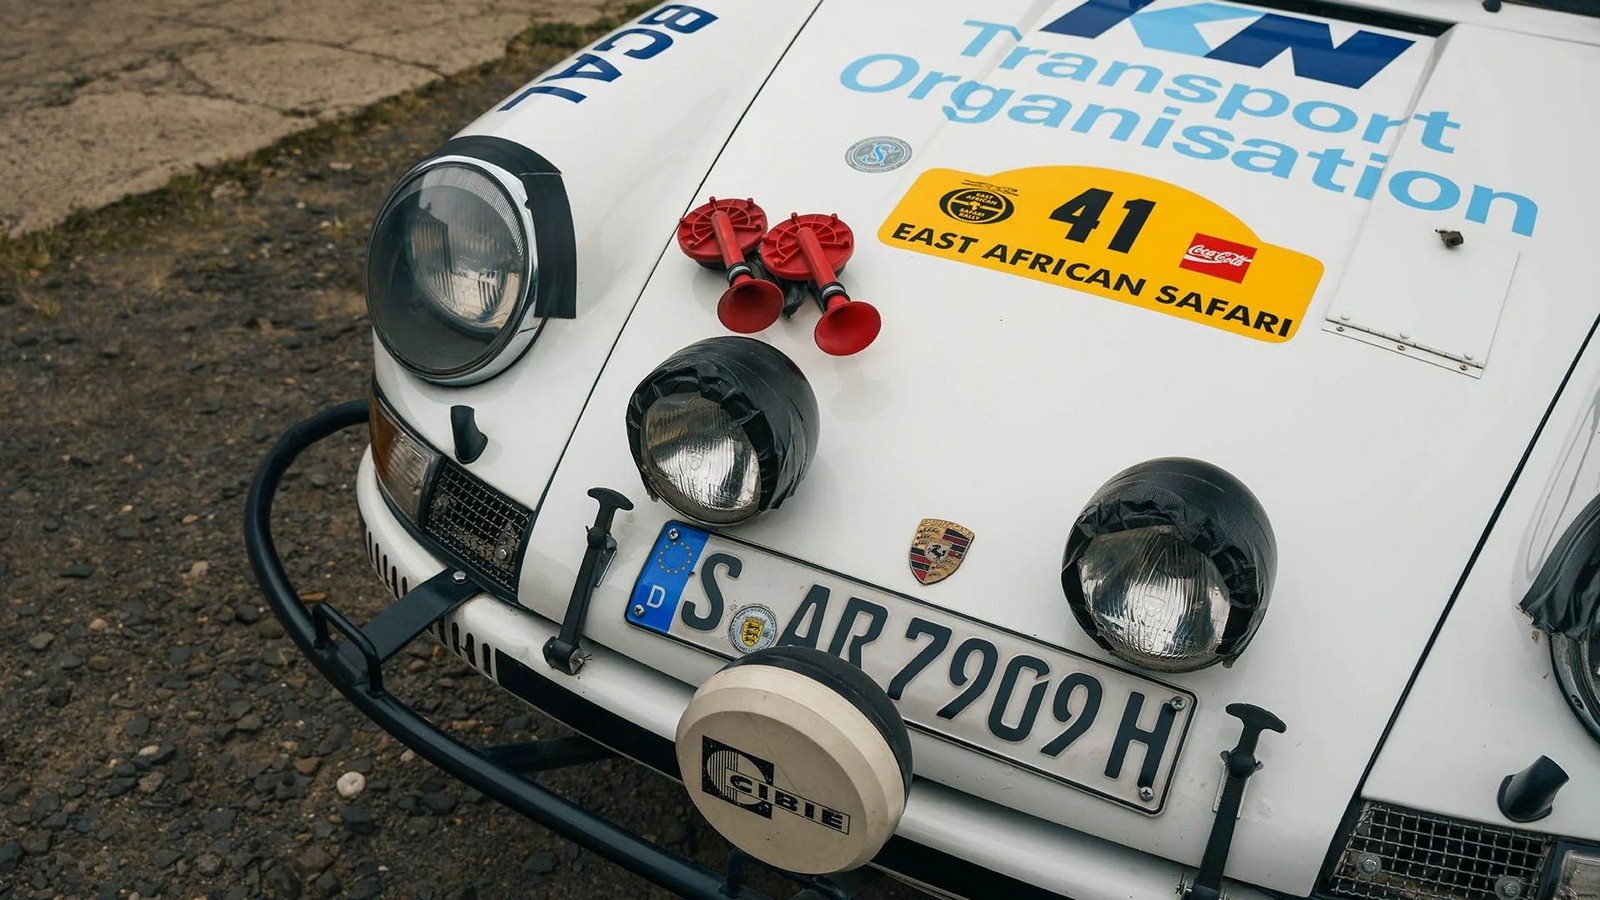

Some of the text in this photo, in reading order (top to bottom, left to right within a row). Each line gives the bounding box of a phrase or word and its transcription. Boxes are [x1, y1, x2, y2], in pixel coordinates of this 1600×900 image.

[960, 19, 1461, 154] Transport
[839, 53, 1539, 237] Organisation
[959, 207, 986, 218] SAFARI
[965, 194, 998, 206] AFRICAN
[976, 192, 994, 200] EAST
[1049, 187, 1157, 254] 41
[891, 222, 1294, 338] EAST AFRICAN SAFARI
[646, 585, 667, 609] D
[681, 552, 743, 631] S
[776, 584, 888, 669] AR
